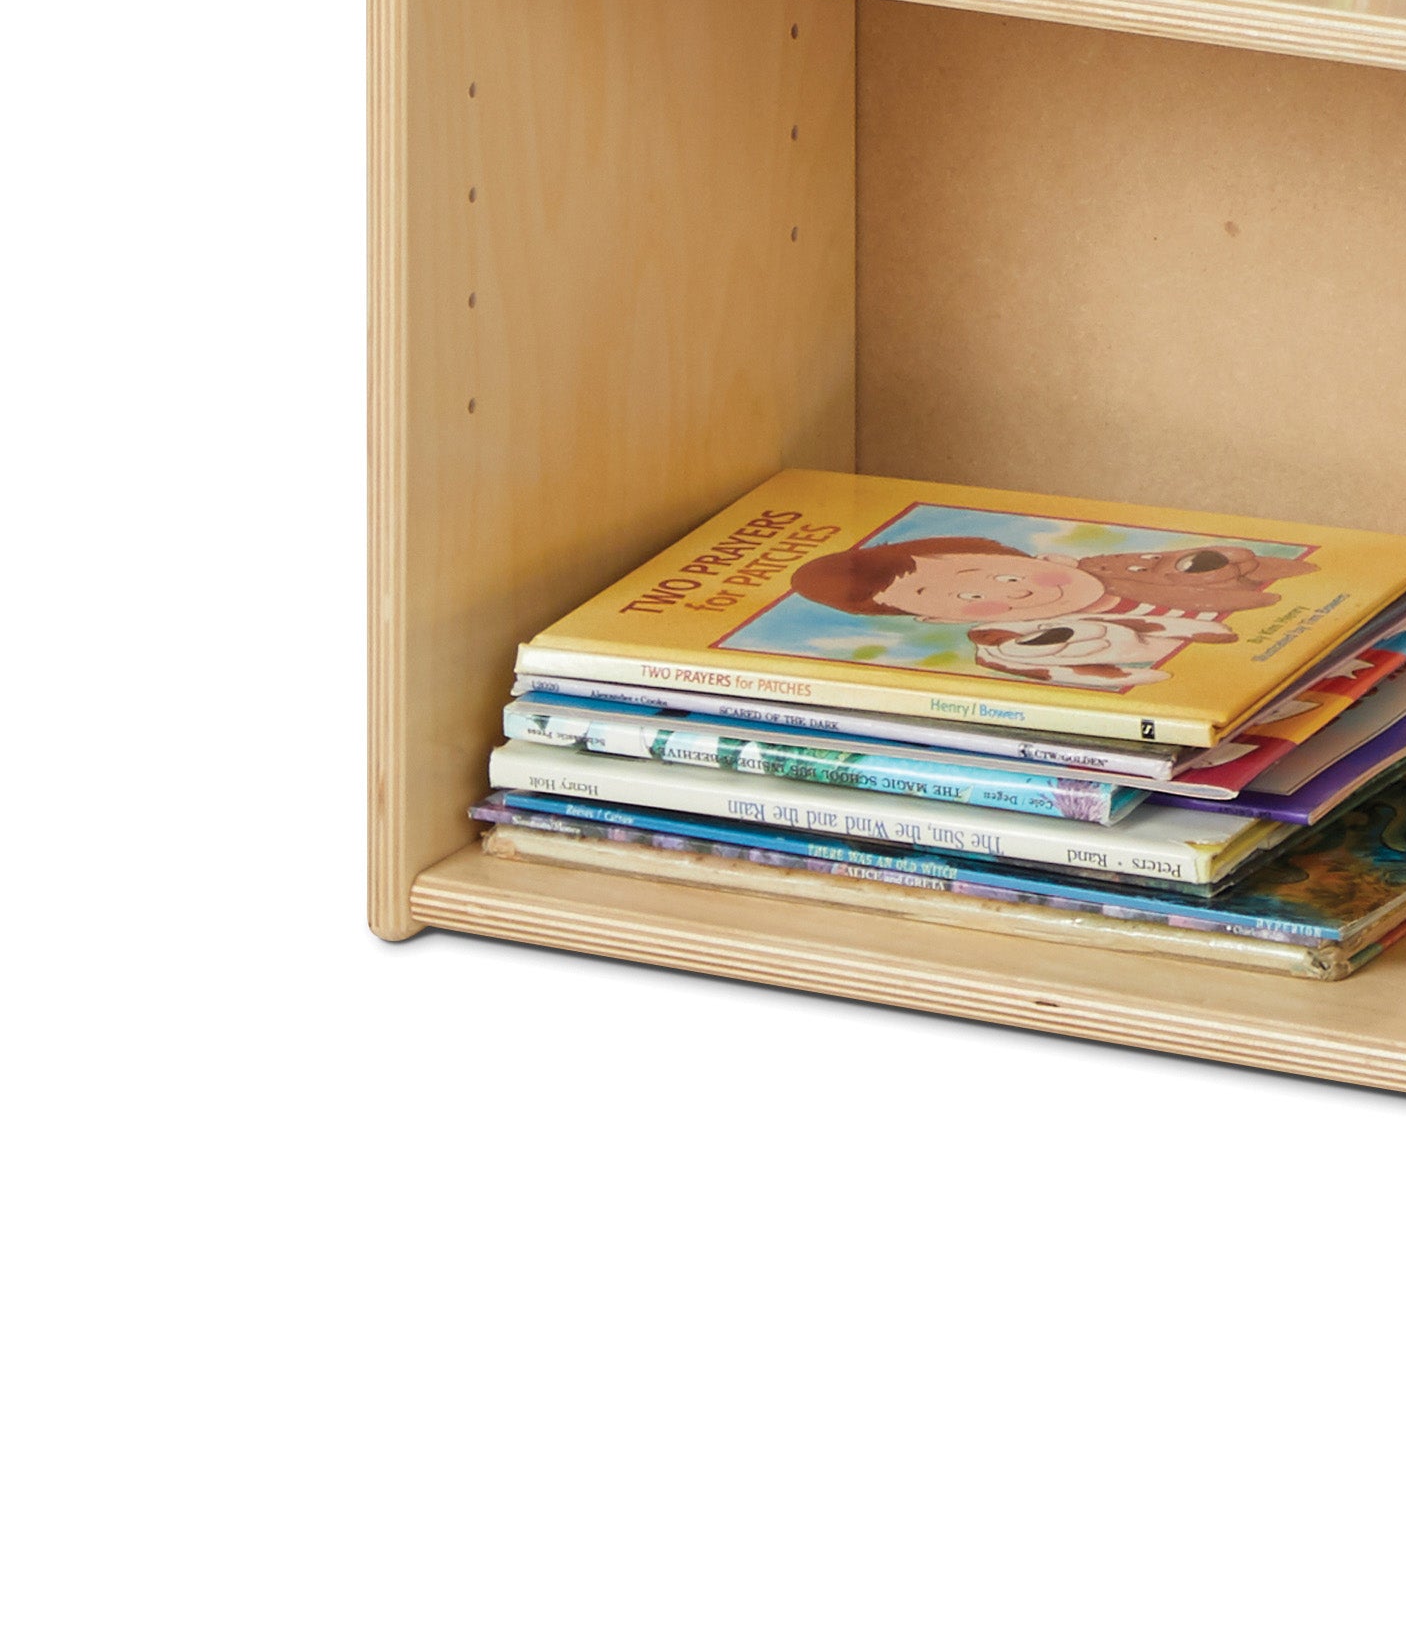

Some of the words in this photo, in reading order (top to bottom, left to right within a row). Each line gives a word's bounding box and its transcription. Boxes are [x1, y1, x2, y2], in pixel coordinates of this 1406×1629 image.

[620, 571, 703, 615] TWO
[698, 509, 804, 579] PRAYERS
[731, 523, 843, 588] PATCHES
[641, 665, 671, 680] TWO
[674, 669, 732, 688] PRAYERS
[757, 678, 812, 697] PATCHES
[979, 704, 1026, 721] Bowers
[561, 777, 599, 797] Henry
